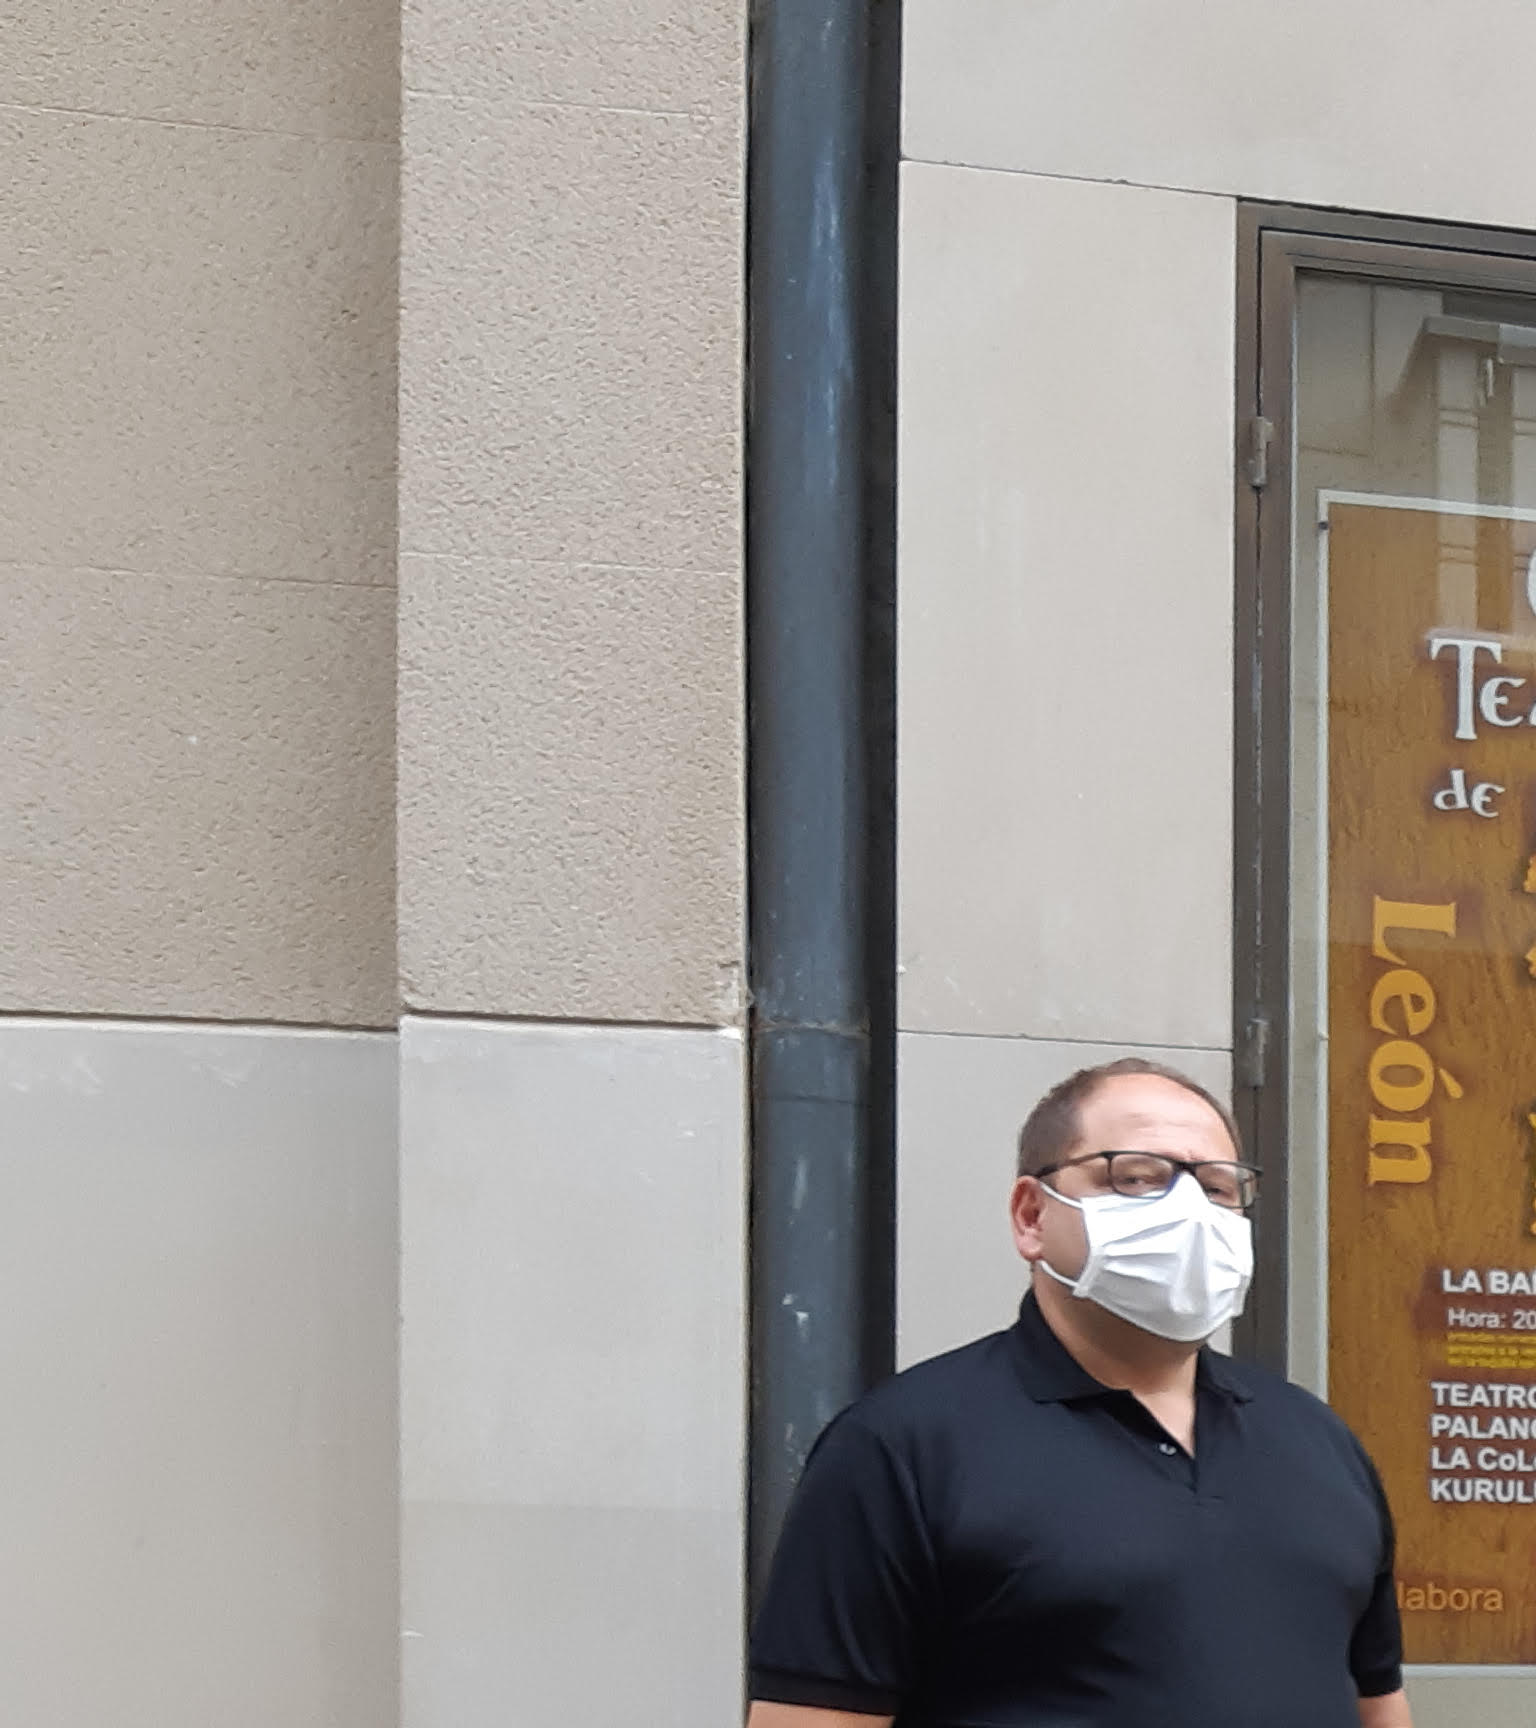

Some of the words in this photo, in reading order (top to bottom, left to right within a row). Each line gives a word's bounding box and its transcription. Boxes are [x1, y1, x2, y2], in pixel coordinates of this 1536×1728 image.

[1433, 769, 1506, 818] de
[1369, 895, 1463, 1187] León
[1442, 1269, 1482, 1294] LA
[1448, 1308, 1506, 1329] Hora:
[1431, 1447, 1471, 1471] LA
[1396, 1581, 1504, 1613] labora
